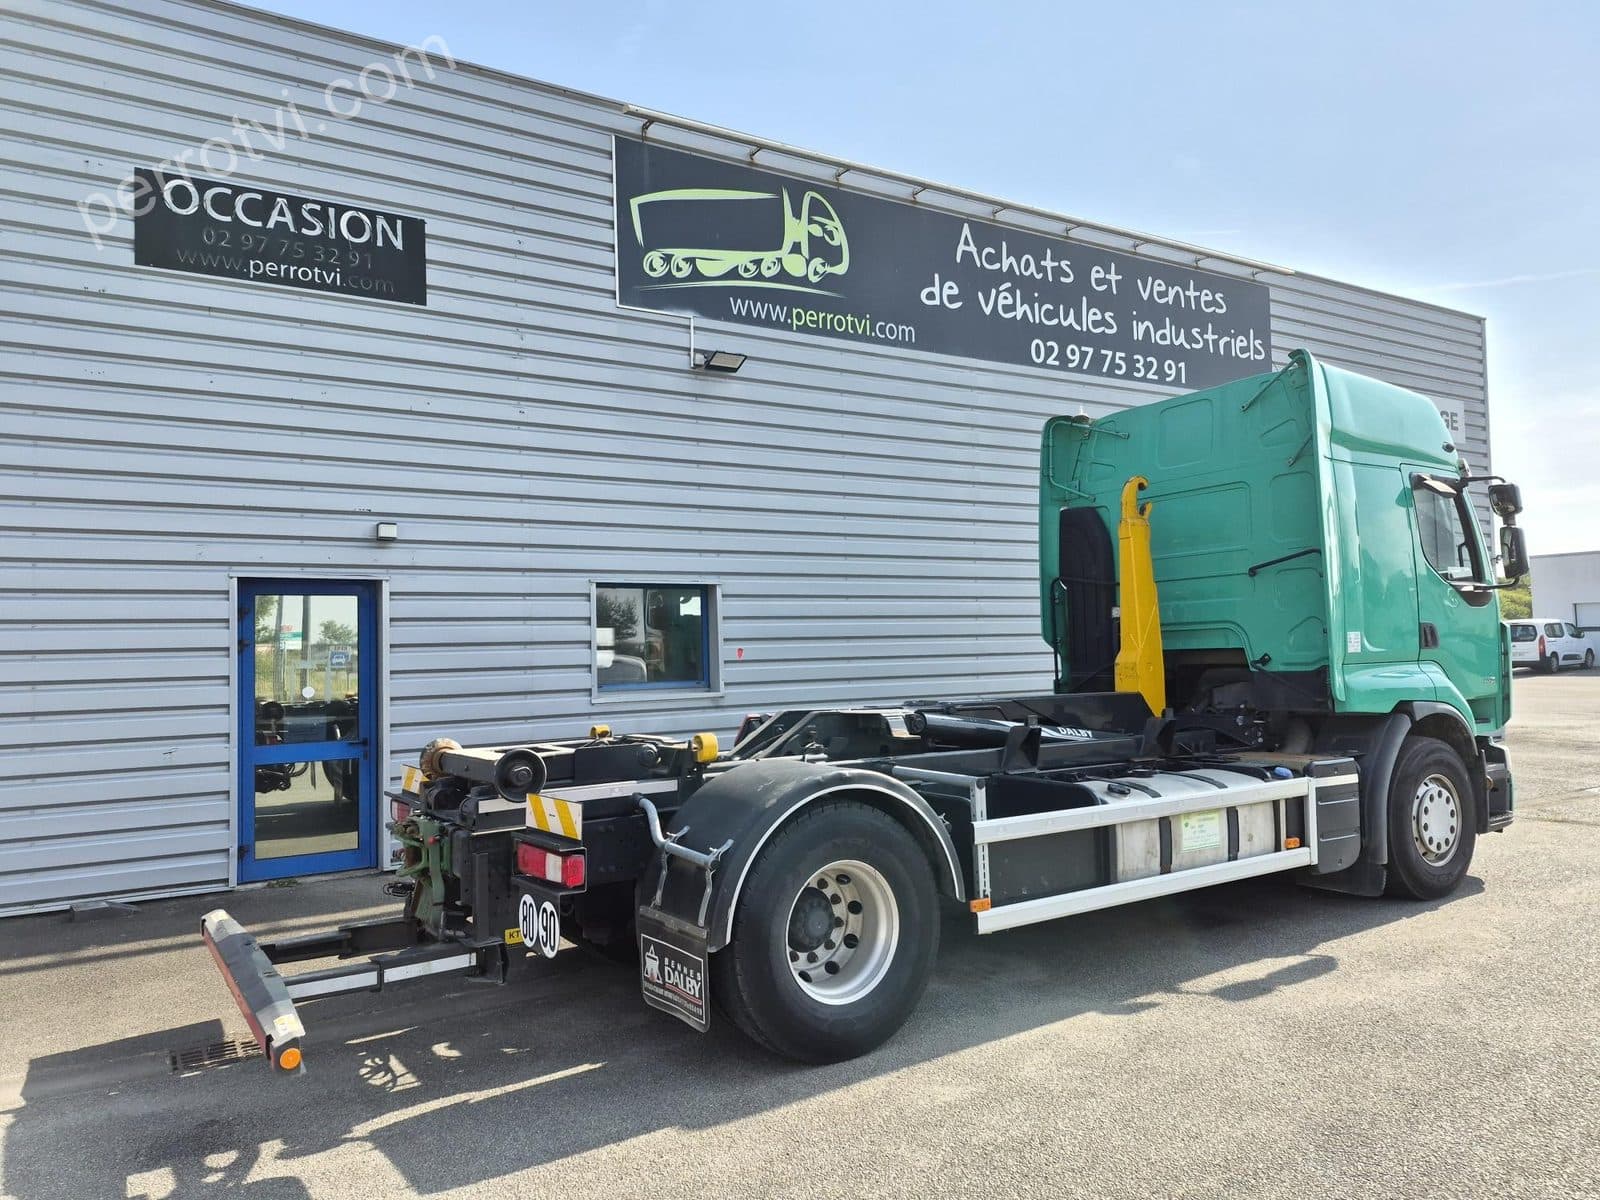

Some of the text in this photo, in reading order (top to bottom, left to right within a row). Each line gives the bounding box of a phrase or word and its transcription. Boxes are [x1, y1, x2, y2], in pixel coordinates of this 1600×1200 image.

[163, 179, 404, 250] OCCASION
[176, 246, 395, 294] www.perrotvi.com
[202, 228, 373, 270] 02 97 75 32 91
[955, 222, 1228, 315] Achats et ventes
[729, 296, 916, 343] www.perrotvi.com
[919, 272, 1267, 361] de véhicules industriels
[1030, 338, 1187, 384] 02 97 75 32 91
[522, 900, 535, 943] 80
[541, 907, 556, 952] 90
[664, 966, 701, 998] DALBY
